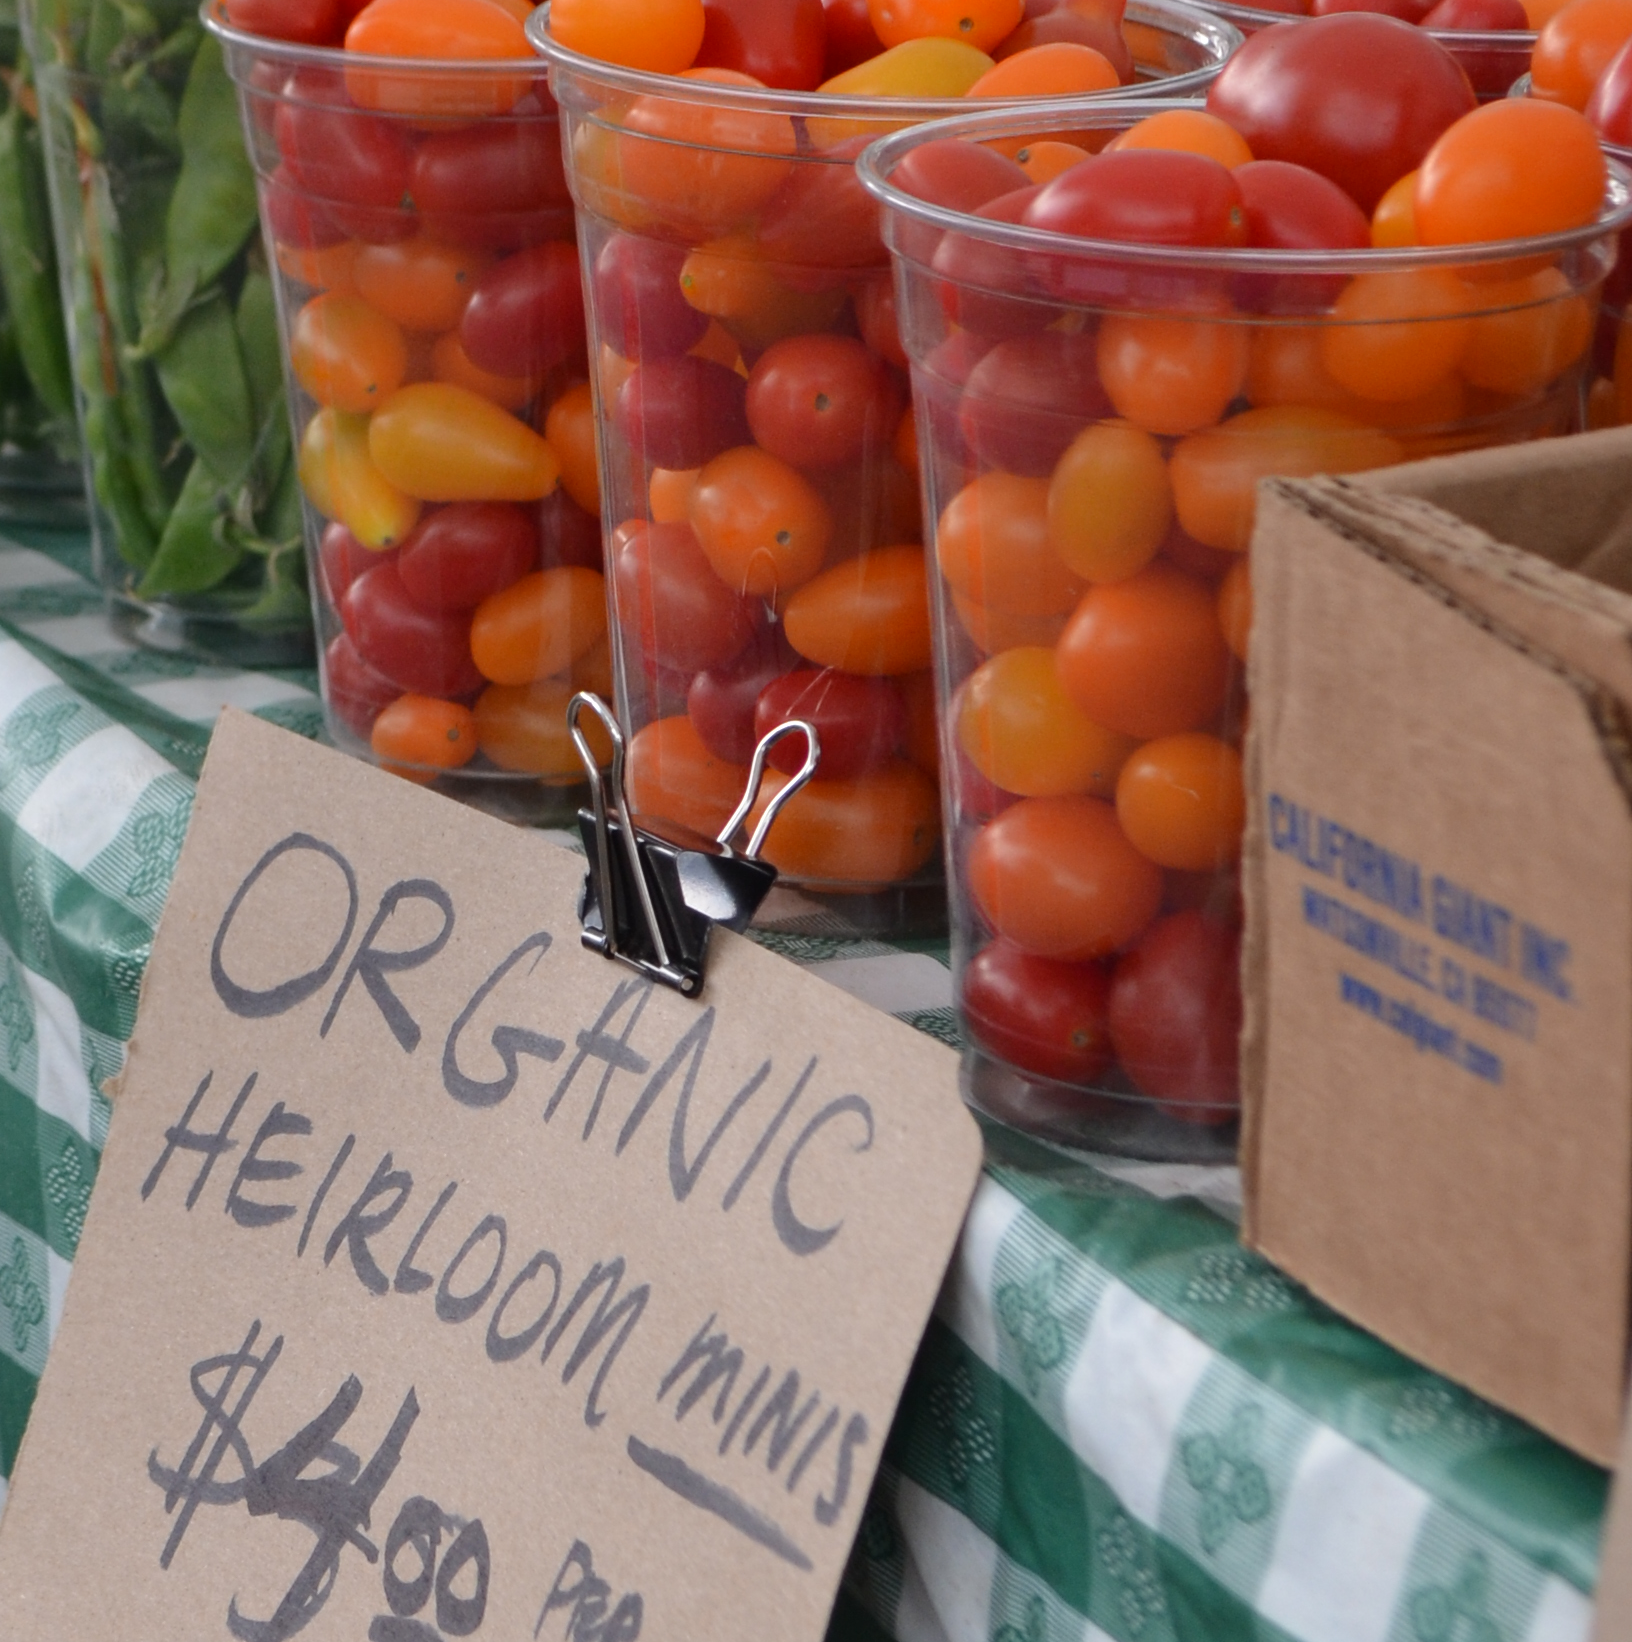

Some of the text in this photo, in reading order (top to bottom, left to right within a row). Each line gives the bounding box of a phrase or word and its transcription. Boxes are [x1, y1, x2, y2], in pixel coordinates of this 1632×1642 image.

[211, 832, 875, 1255] ORGANIC
[142, 1069, 870, 1527] HEIRLOOM MINIS
